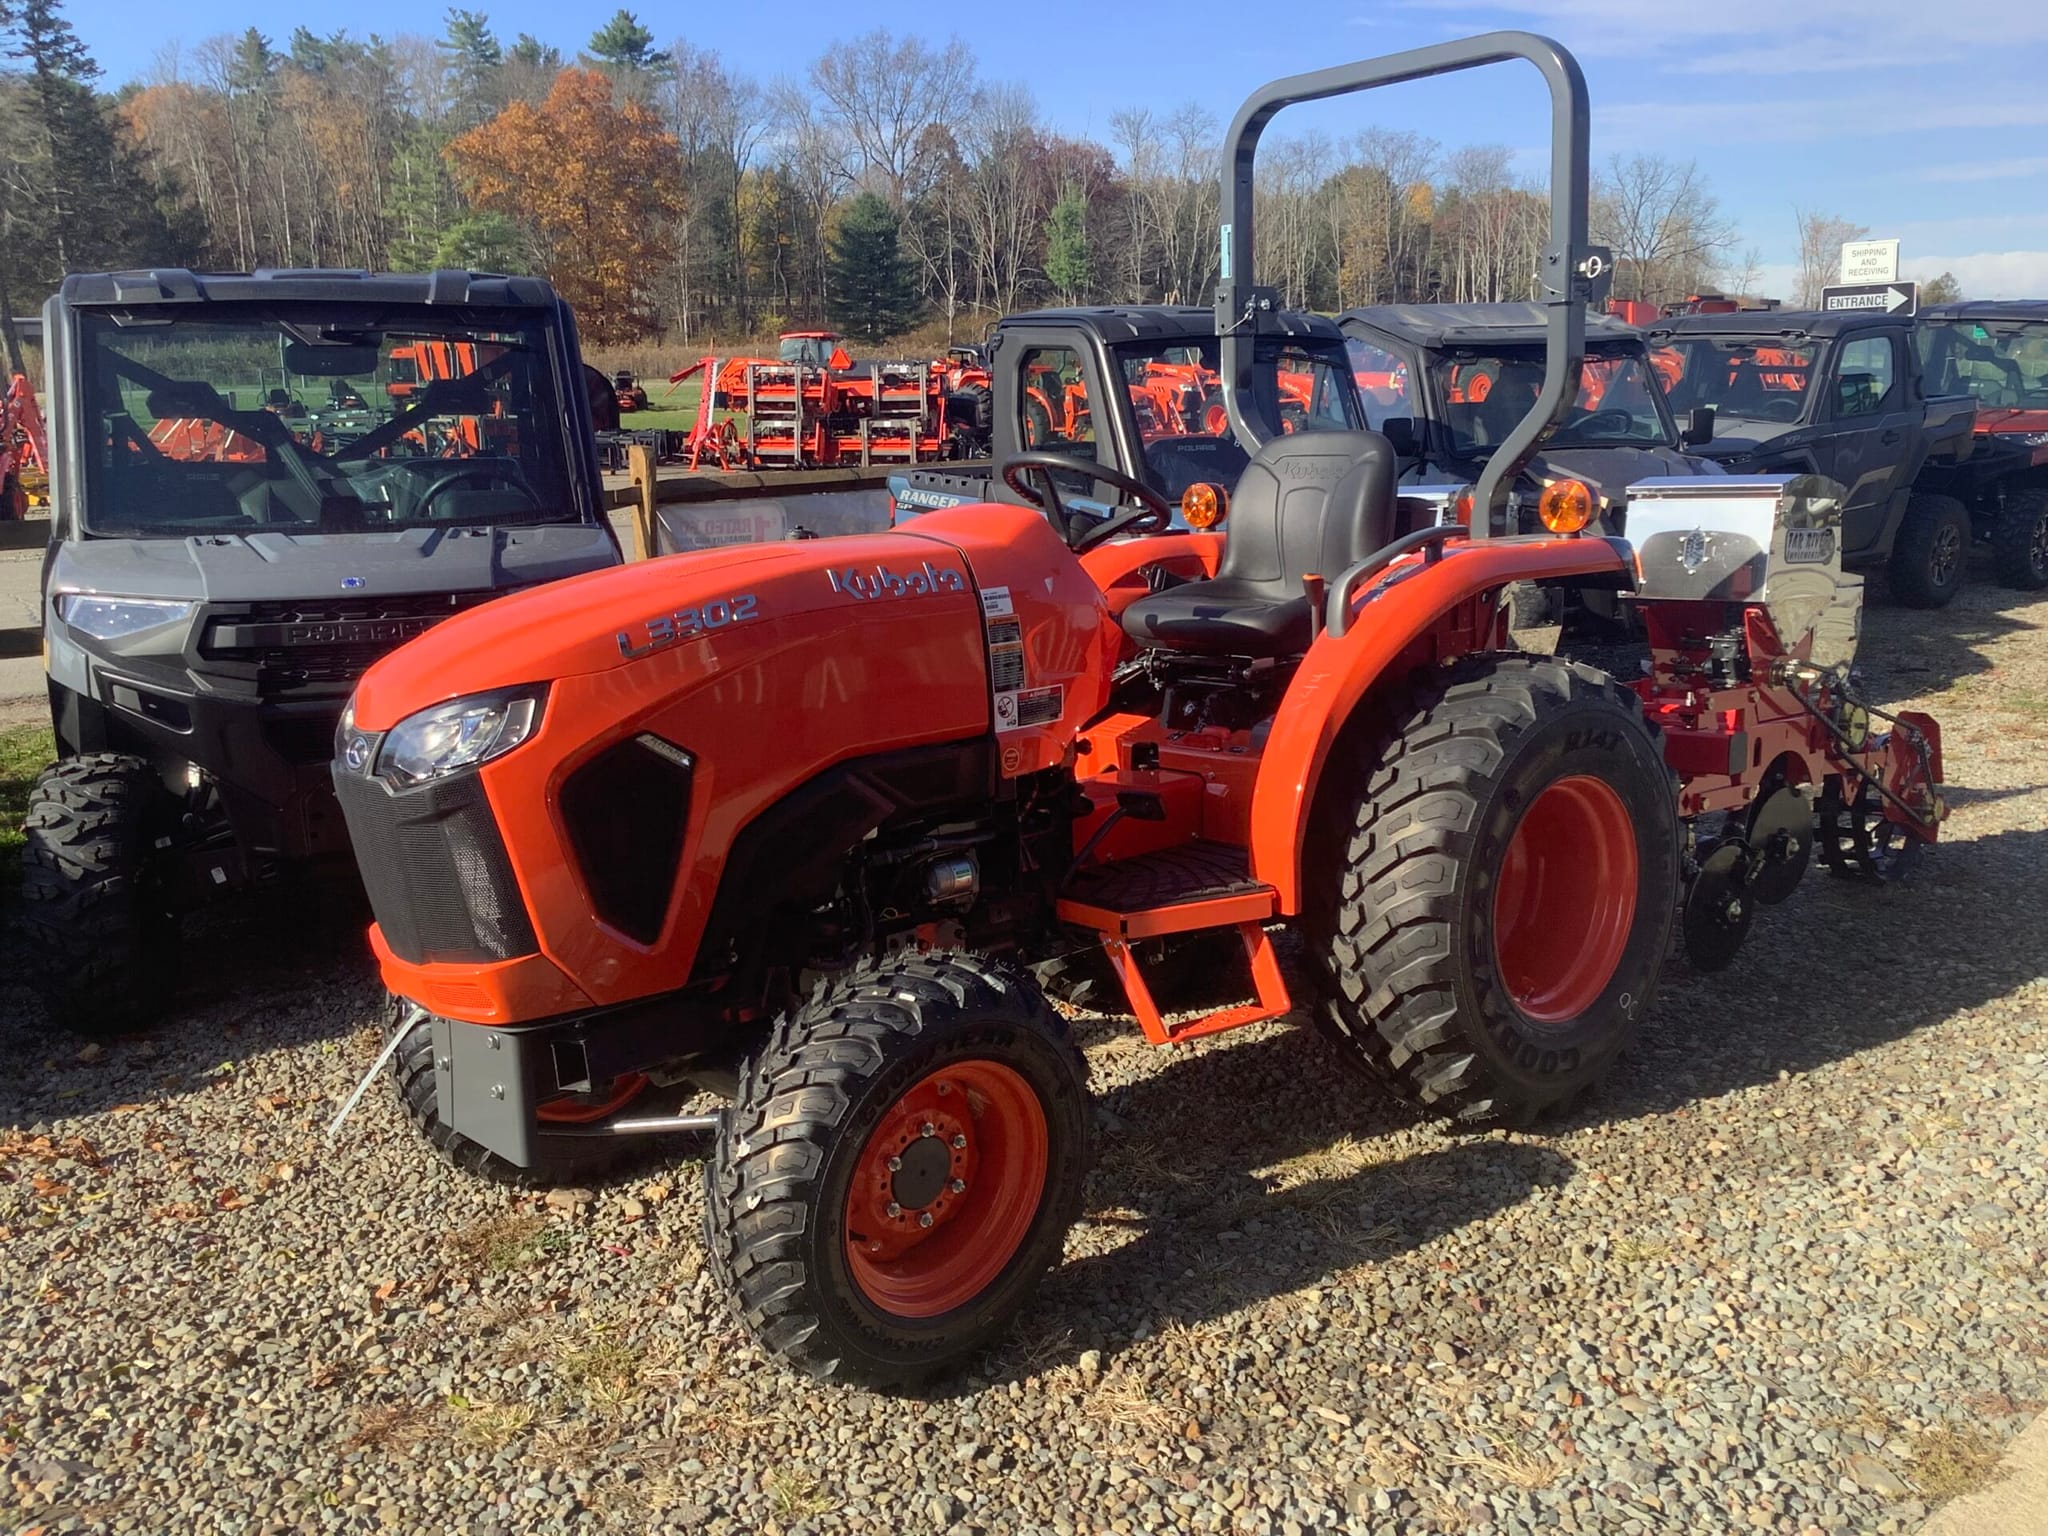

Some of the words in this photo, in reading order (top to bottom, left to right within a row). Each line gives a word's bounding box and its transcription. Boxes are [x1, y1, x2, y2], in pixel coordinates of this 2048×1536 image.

[1852, 248, 1887, 258] SHIPPING
[1861, 258, 1877, 266] AND
[1848, 267, 1889, 276] RECEIVING
[1829, 295, 1888, 308] ENTRANCE
[1176, 444, 1217, 452] POLARIS
[899, 489, 960, 509] RANGER
[826, 561, 965, 600] Kubota
[616, 594, 758, 658] L3302
